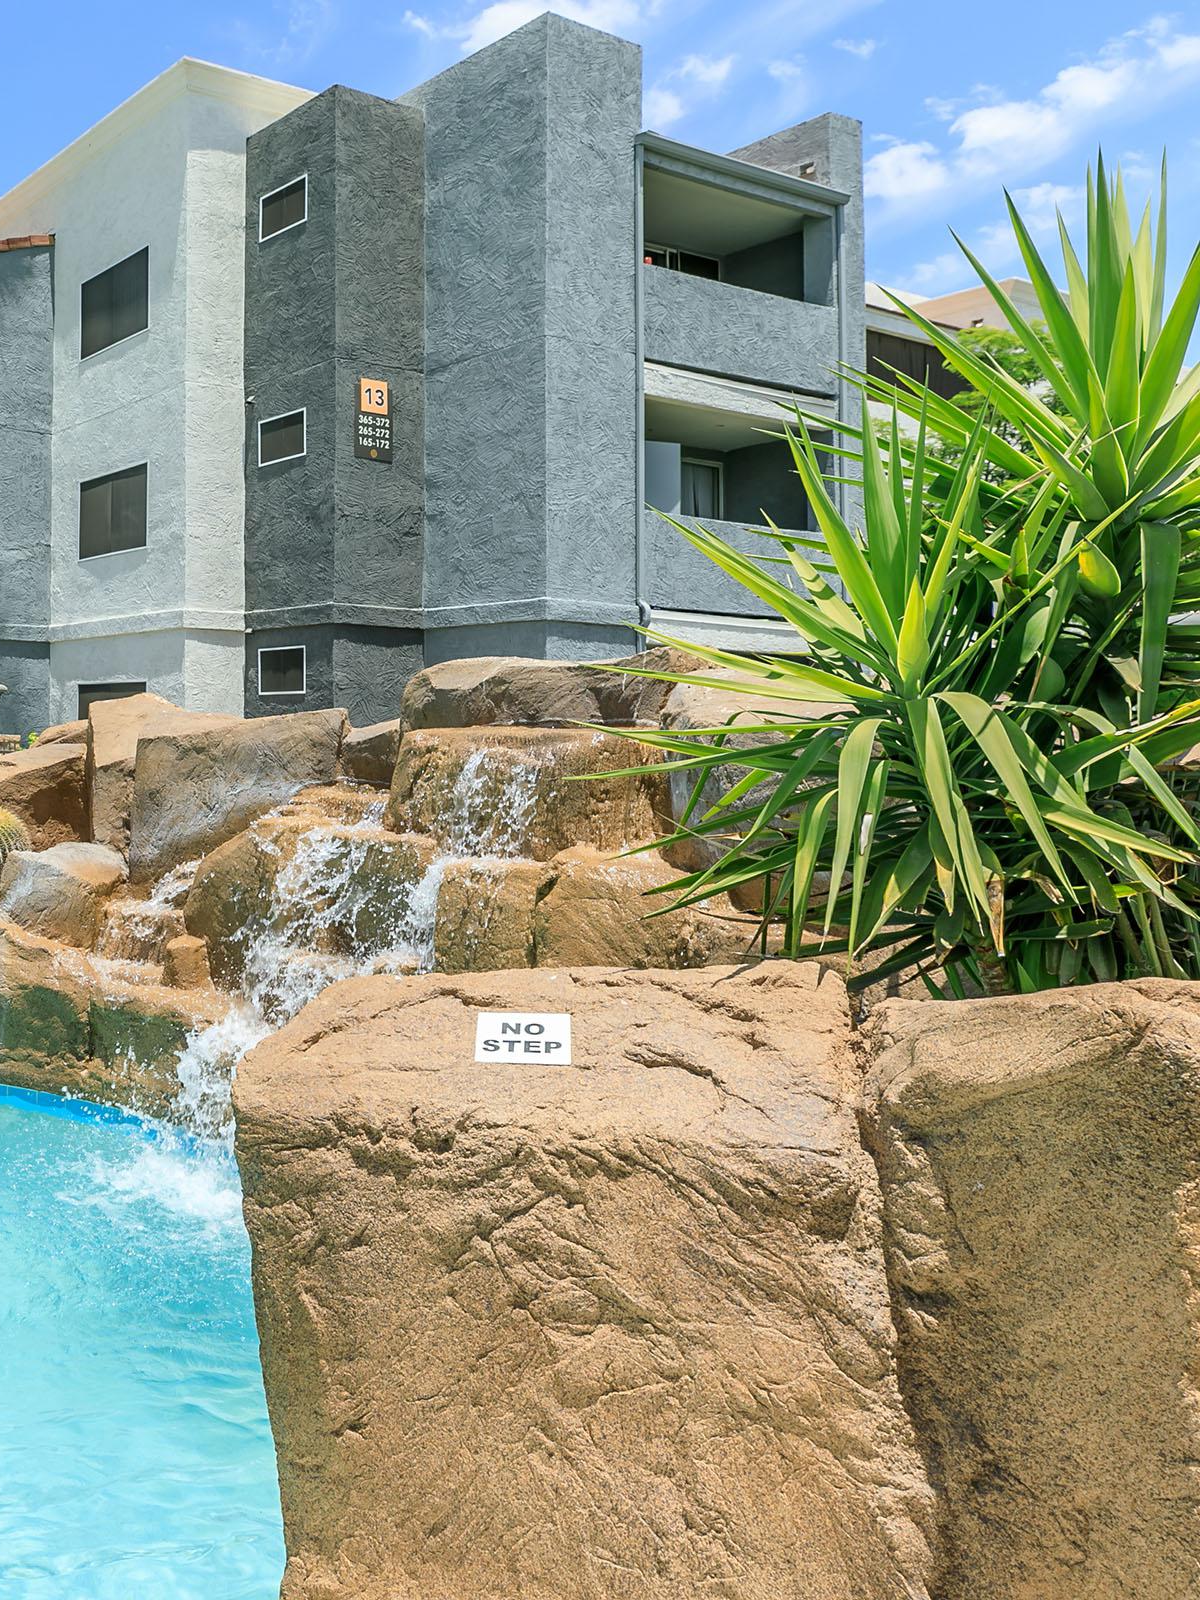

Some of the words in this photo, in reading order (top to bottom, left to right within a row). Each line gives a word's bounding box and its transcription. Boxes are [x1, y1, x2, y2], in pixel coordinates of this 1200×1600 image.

[364, 388, 385, 407] 13
[358, 414, 390, 428] 365-372
[358, 426, 390, 439] 265-272
[358, 436, 390, 449] 165-172
[501, 1022, 545, 1035] NO
[482, 1039, 562, 1054] STEP
